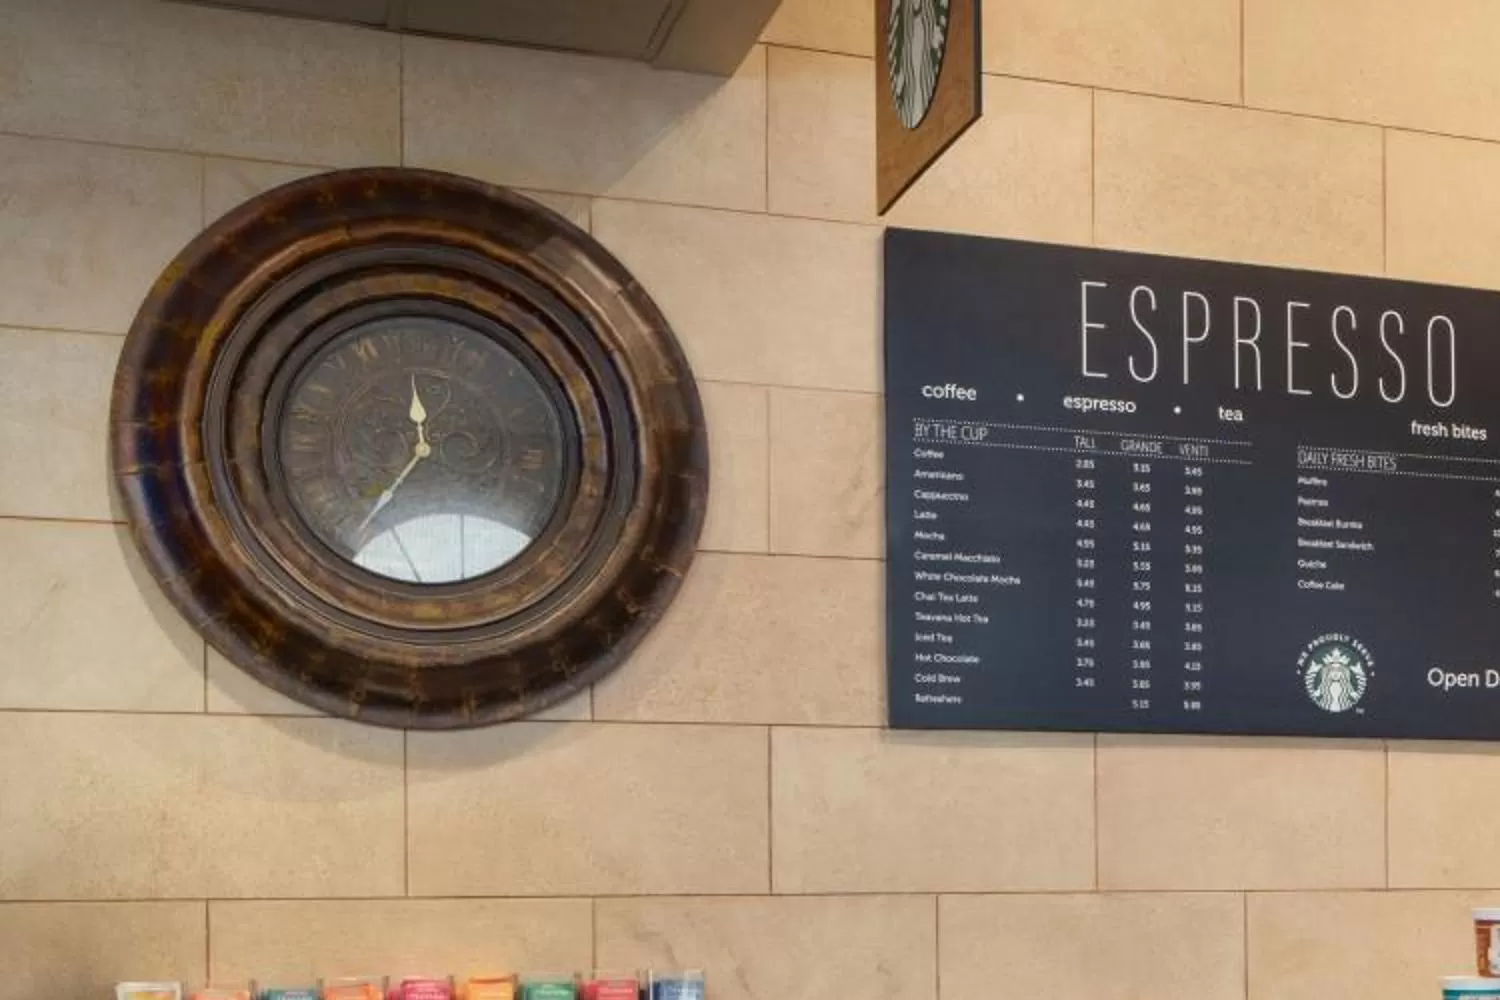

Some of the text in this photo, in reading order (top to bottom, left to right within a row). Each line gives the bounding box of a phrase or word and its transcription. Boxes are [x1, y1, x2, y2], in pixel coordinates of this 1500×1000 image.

[1081, 279, 1457, 408] ESPRESSO
[921, 382, 1245, 422] coffee espresso tea
[914, 422, 988, 441] BY THE CUP
[1410, 419, 1488, 441] fresh bites
[1074, 435, 1209, 457] TALL GRANDE VENTI
[1297, 449, 1398, 472] DAILY FRESH BITES
[1427, 667, 1481, 692] Open
